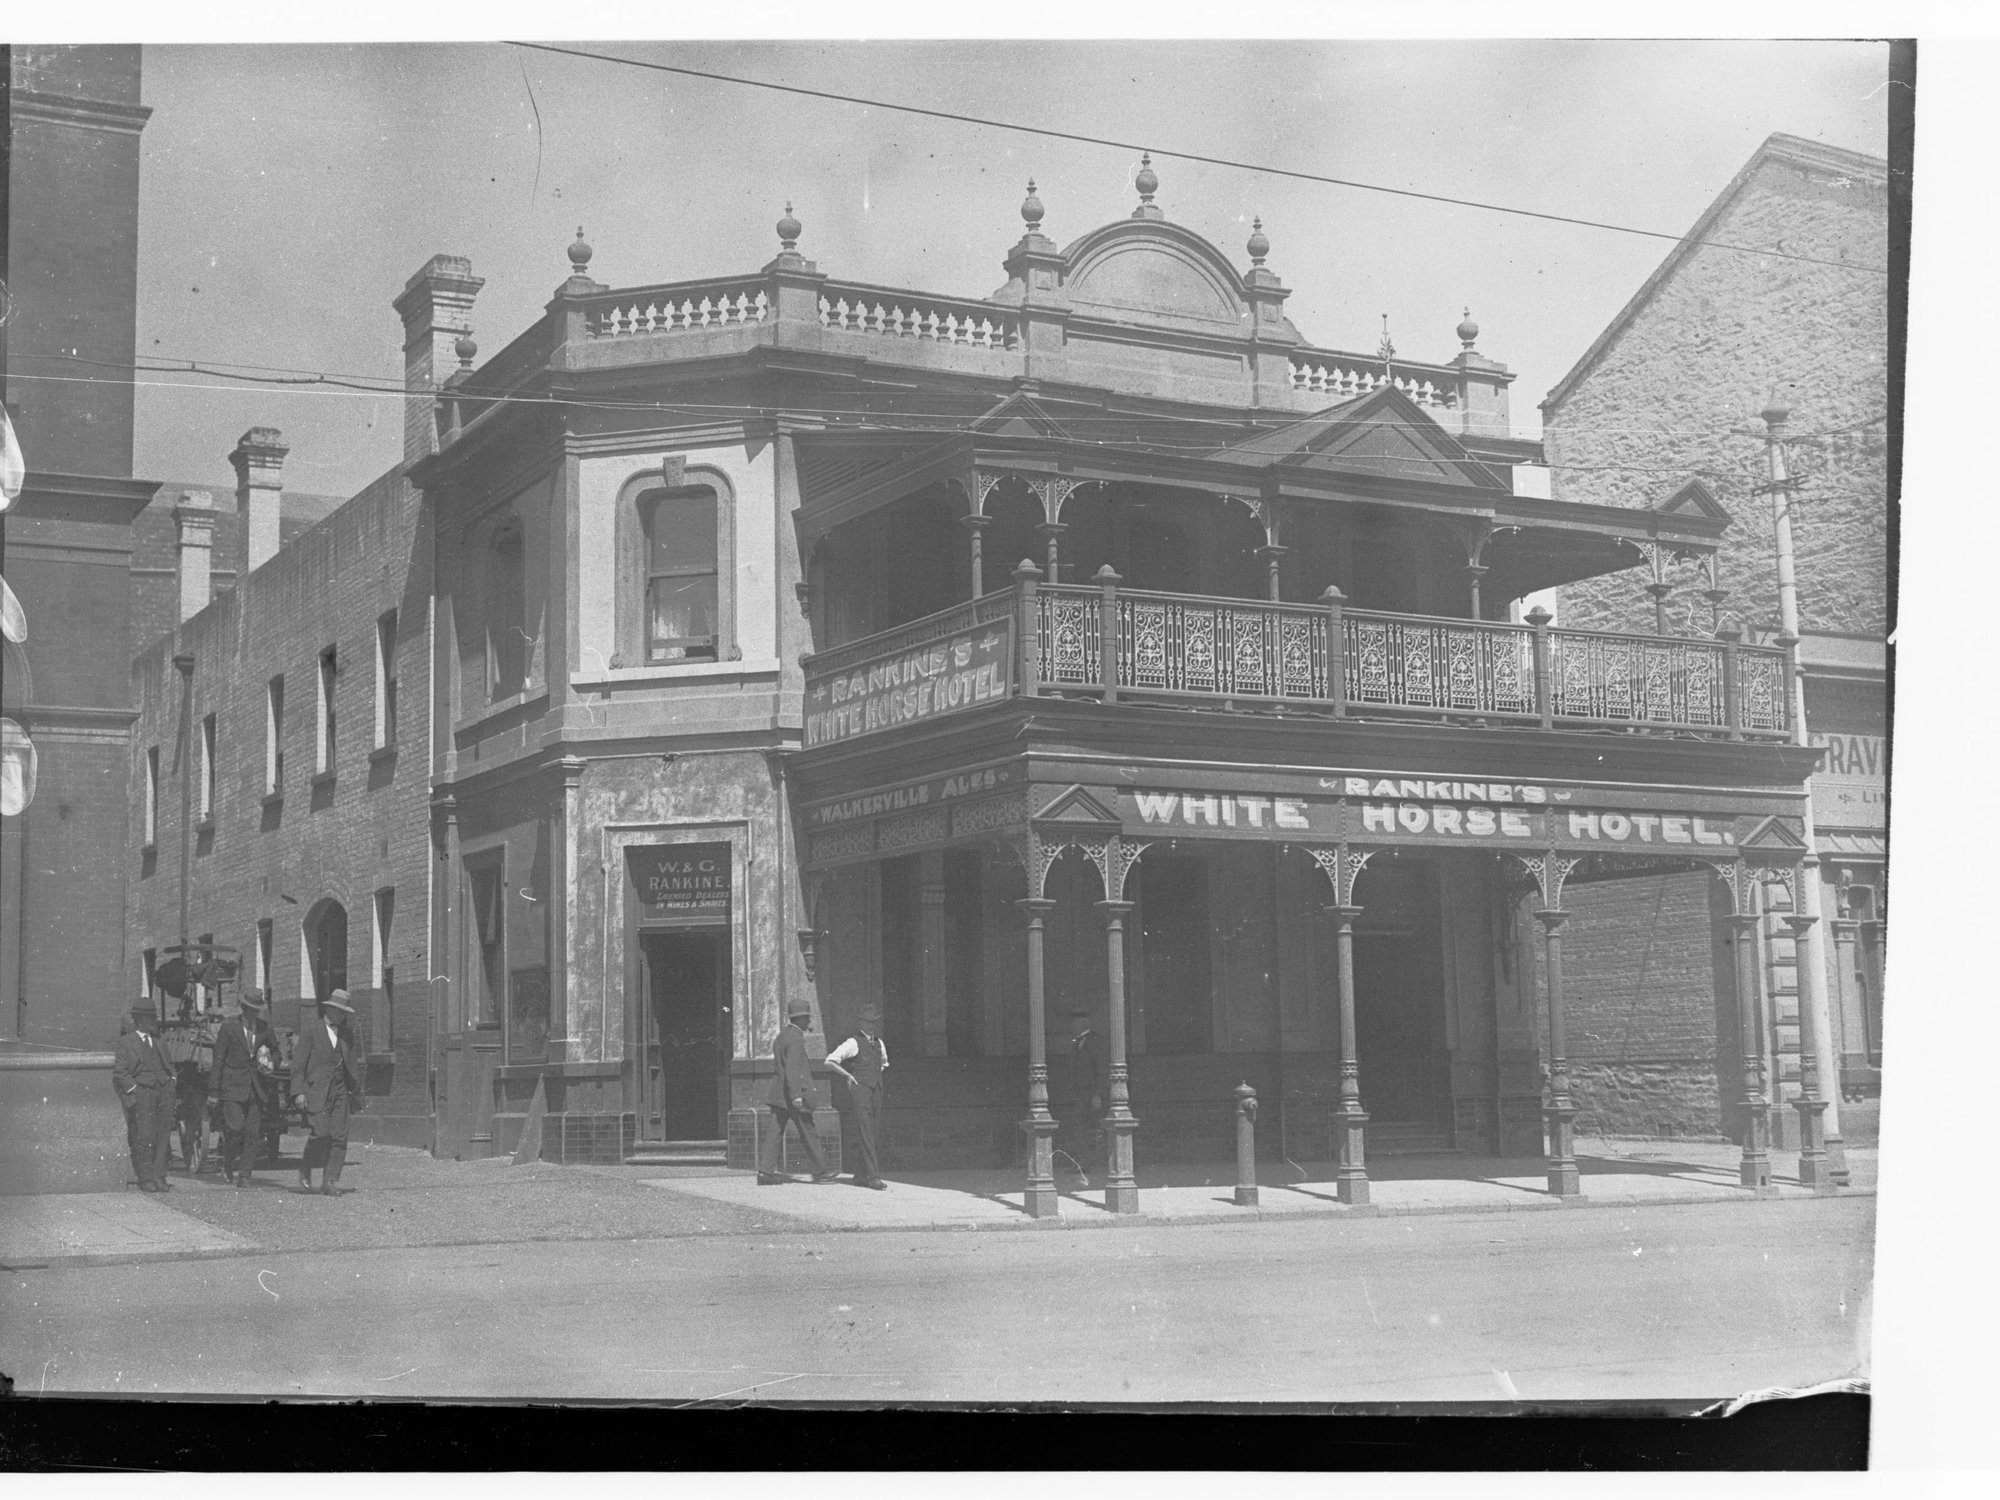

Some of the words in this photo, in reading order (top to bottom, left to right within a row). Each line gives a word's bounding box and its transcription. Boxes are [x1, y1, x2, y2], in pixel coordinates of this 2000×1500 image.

[831, 636, 972, 704] RANKINE'S
[807, 701, 862, 744] WHITE
[865, 681, 934, 730] HORSE
[934, 661, 1006, 712] HOTEL
[819, 783, 929, 824] WALKERVILLE
[941, 769, 996, 800] ALES
[1133, 790, 1310, 829] WHITE
[1362, 802, 1532, 838] HORSE
[1345, 777, 1547, 804] RANKINE'S
[682, 862, 693, 873] &
